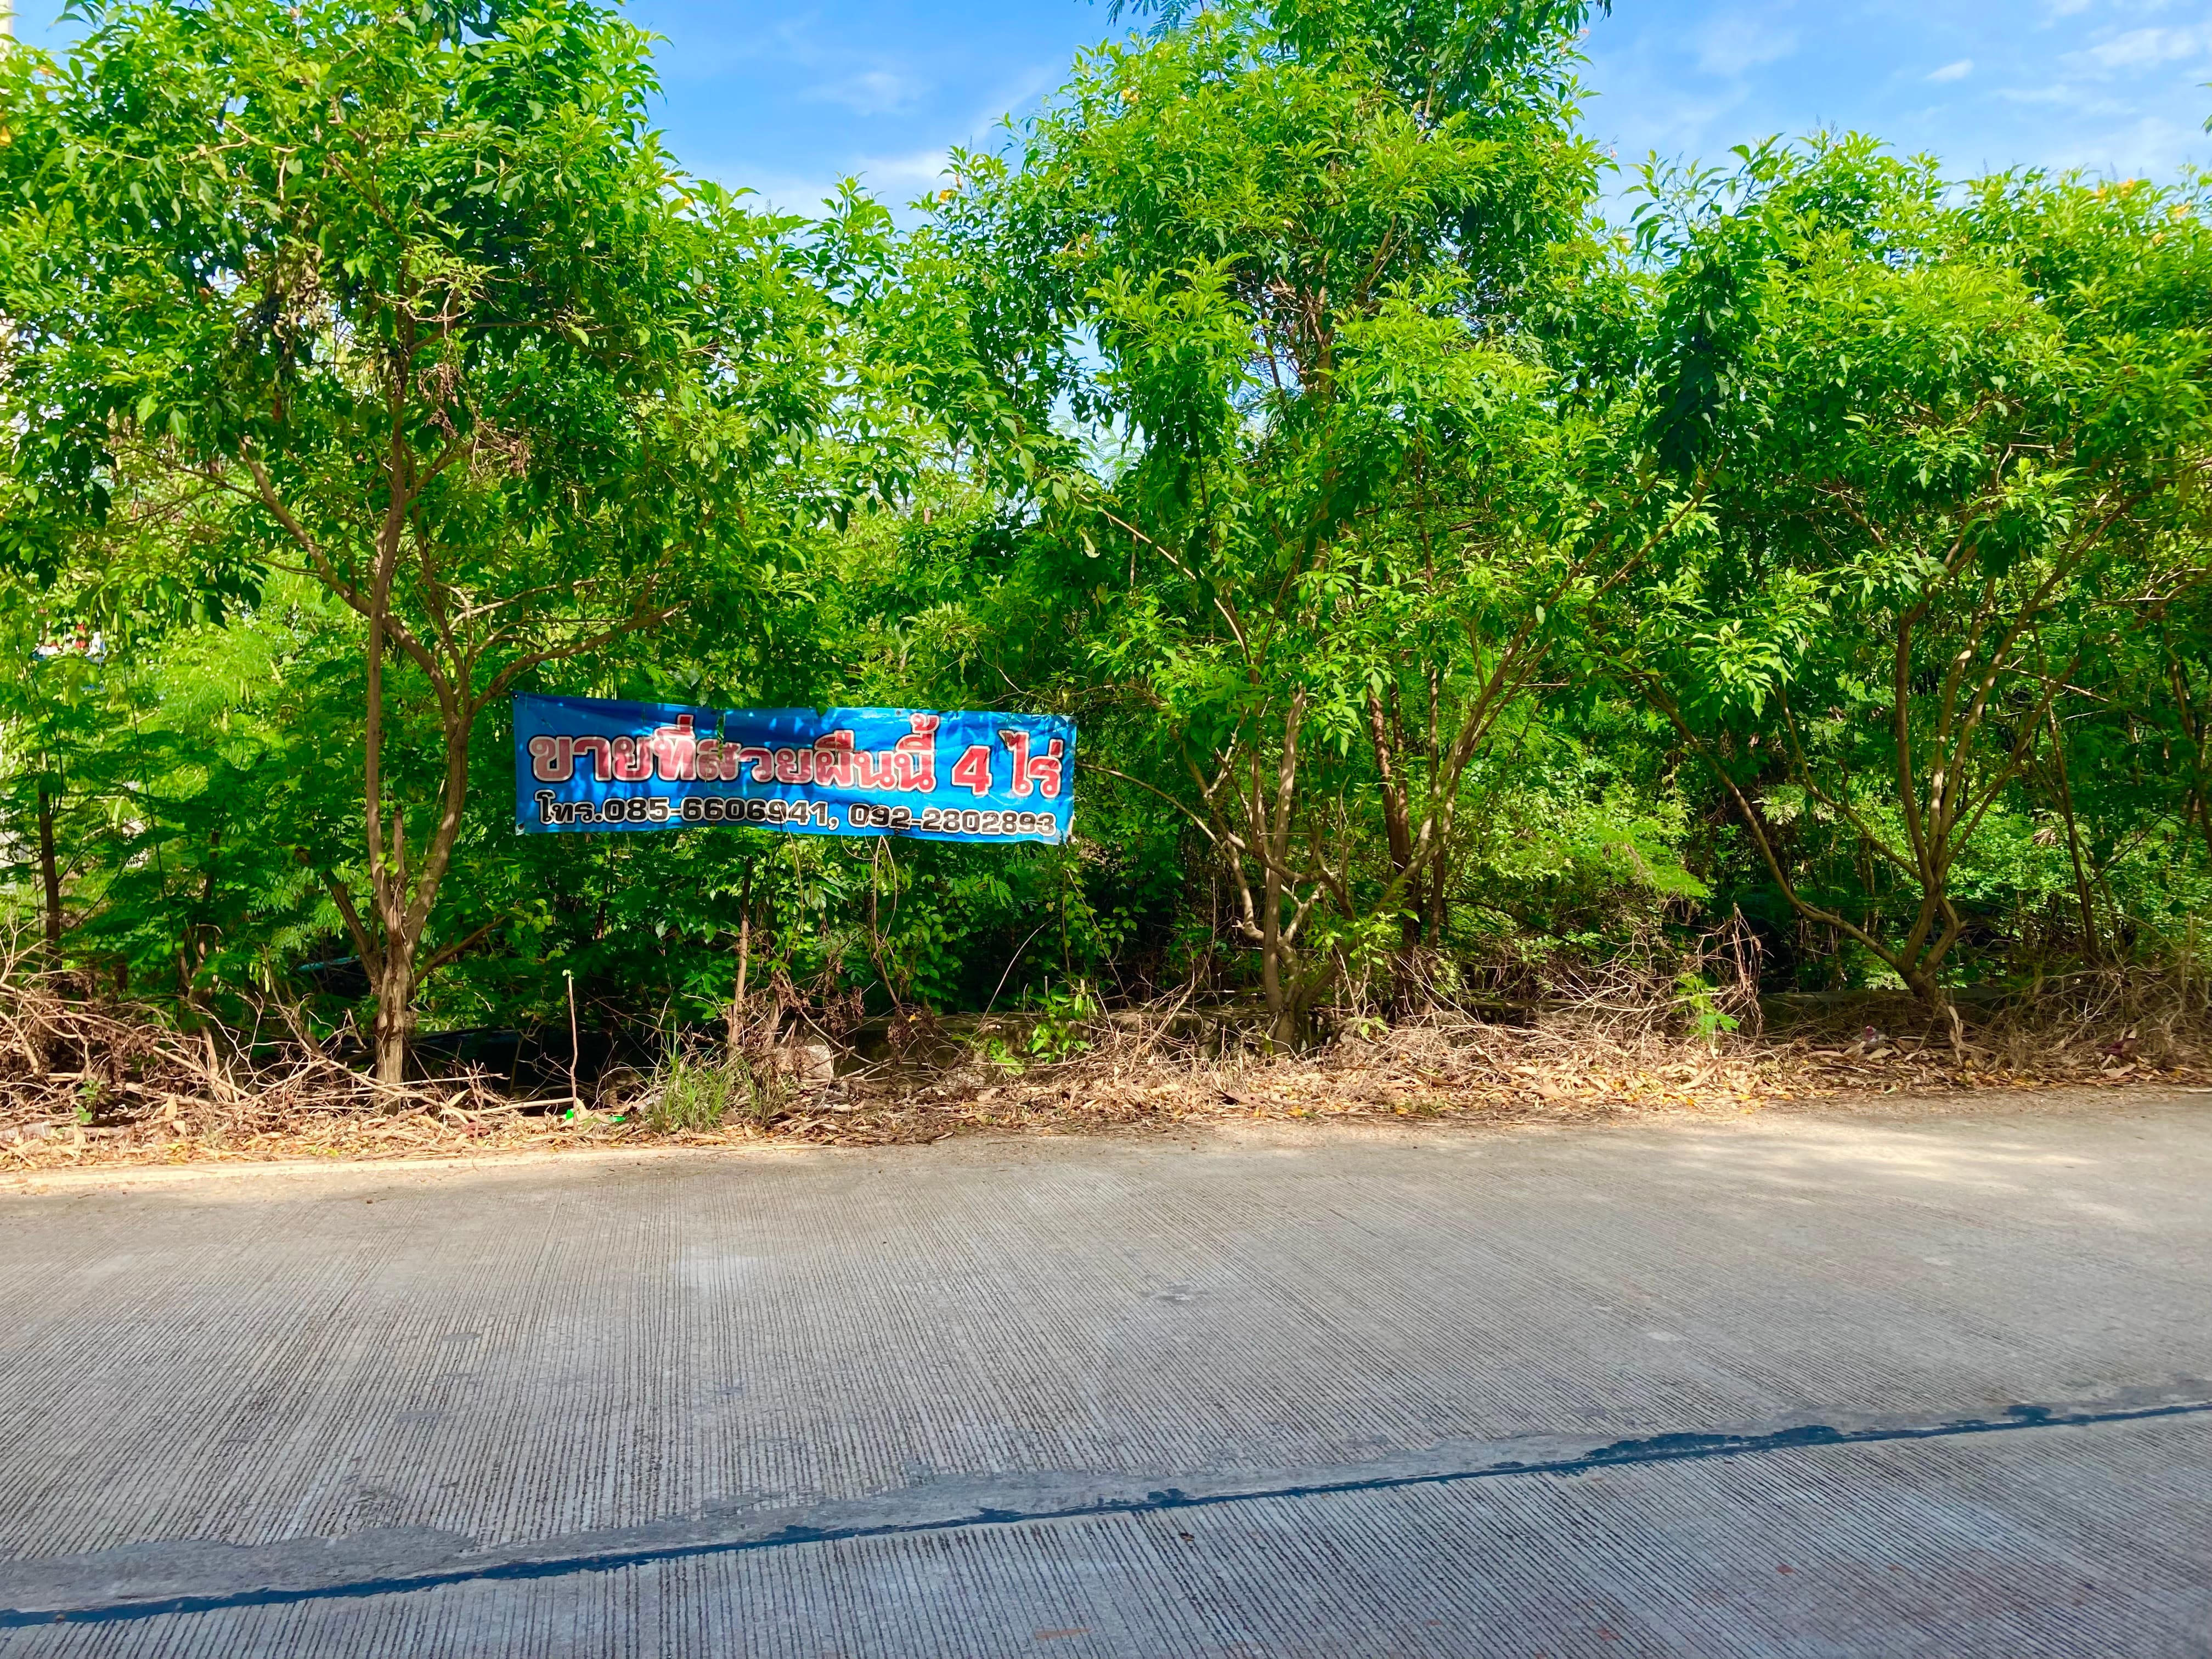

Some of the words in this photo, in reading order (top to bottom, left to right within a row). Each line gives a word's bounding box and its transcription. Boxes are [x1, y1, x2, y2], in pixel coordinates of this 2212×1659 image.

[952, 745, 993, 797] 4
[999, 730, 1064, 799] ไร่
[848, 803, 1057, 836] 092-2802893
